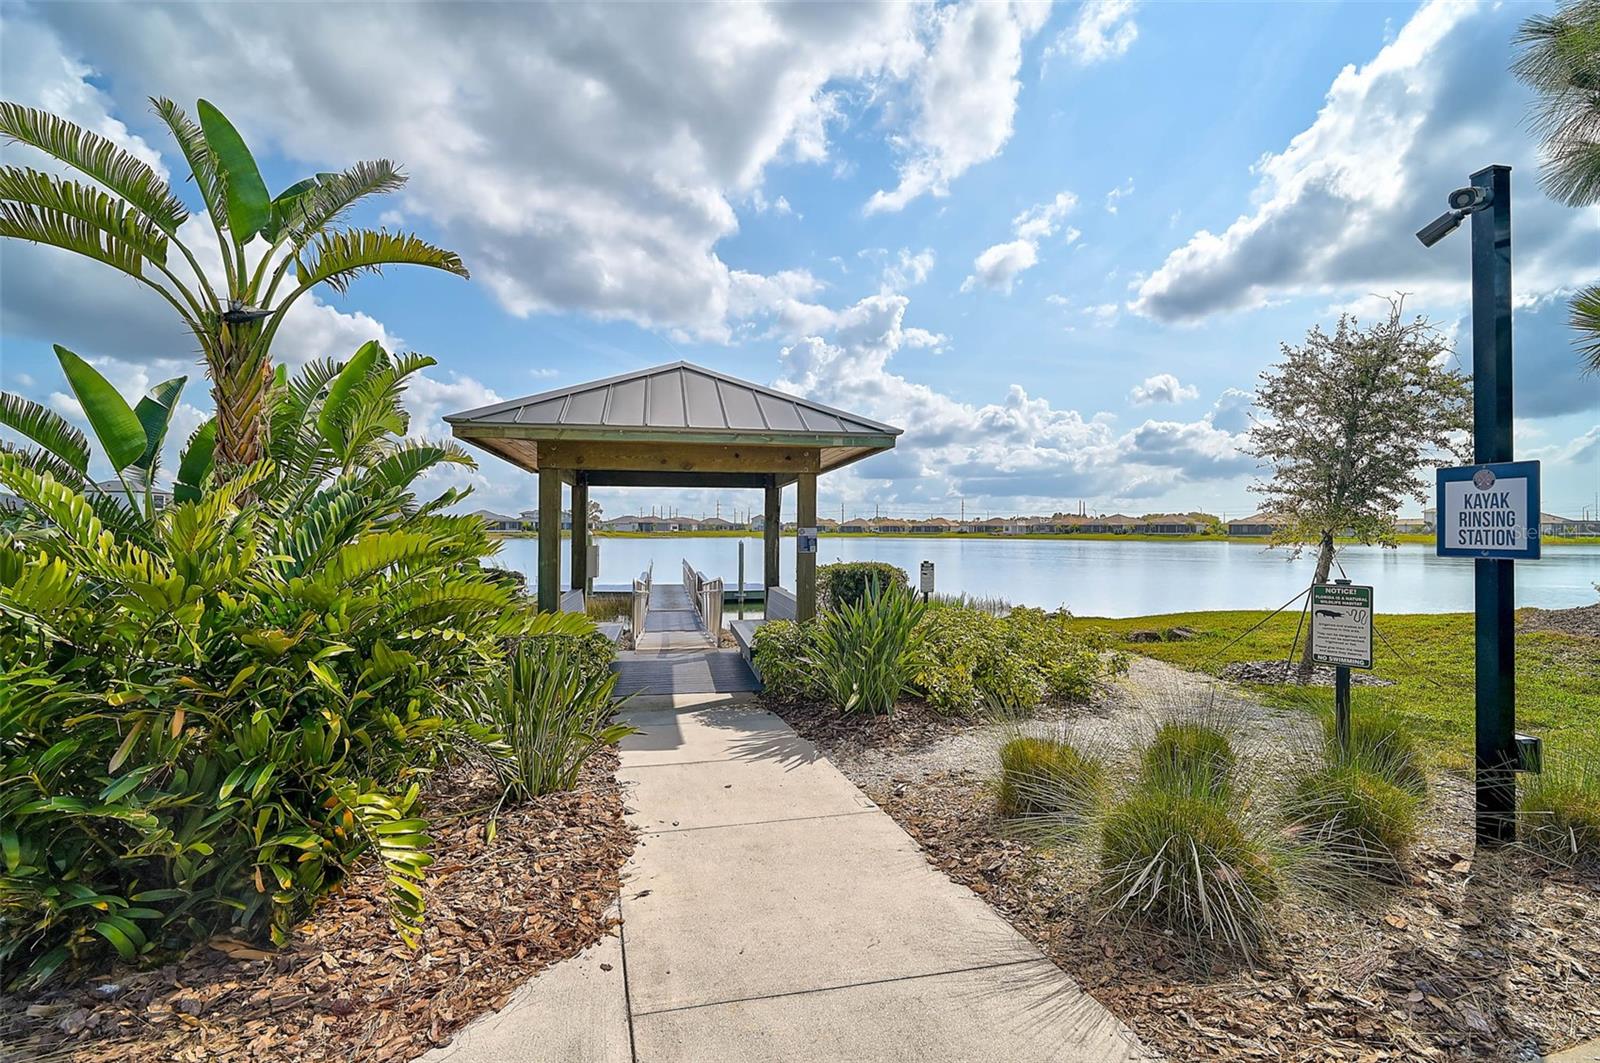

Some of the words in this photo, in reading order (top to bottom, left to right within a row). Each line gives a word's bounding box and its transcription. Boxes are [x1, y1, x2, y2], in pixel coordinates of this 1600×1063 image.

[1464, 492, 1510, 509] KAYAK
[1459, 511, 1515, 527] RINSING
[1458, 529, 1516, 546] STATION
[1328, 656, 1365, 665] SWIMMING
